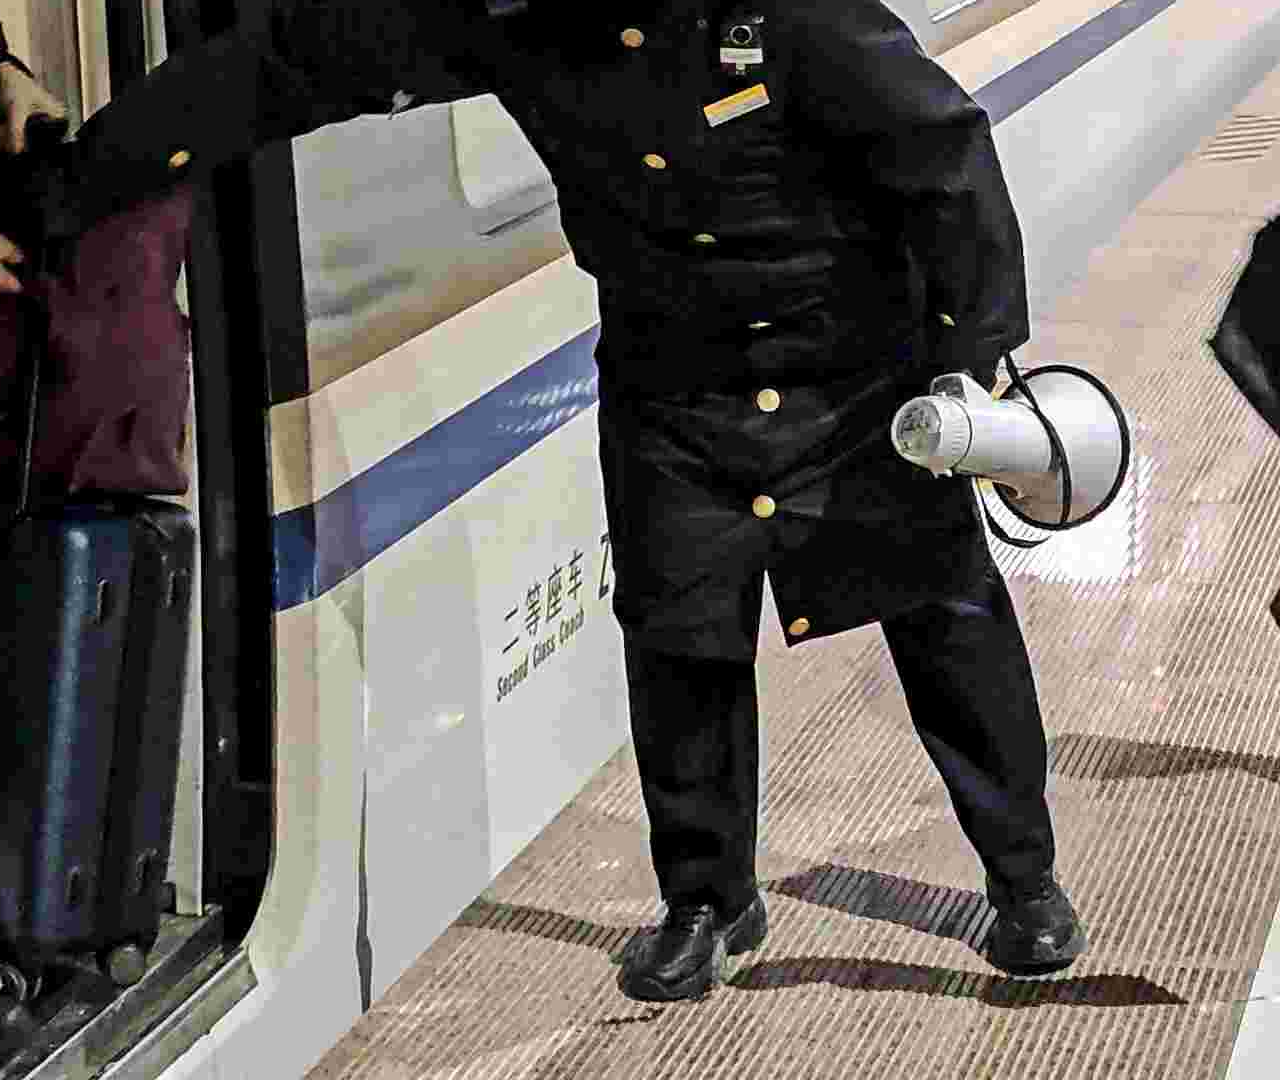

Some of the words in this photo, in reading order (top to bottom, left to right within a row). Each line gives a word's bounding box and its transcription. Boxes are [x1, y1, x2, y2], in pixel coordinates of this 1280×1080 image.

[501, 547, 584, 655] 二等座车
[496, 651, 530, 704] Second
[532, 631, 557, 669] Class
